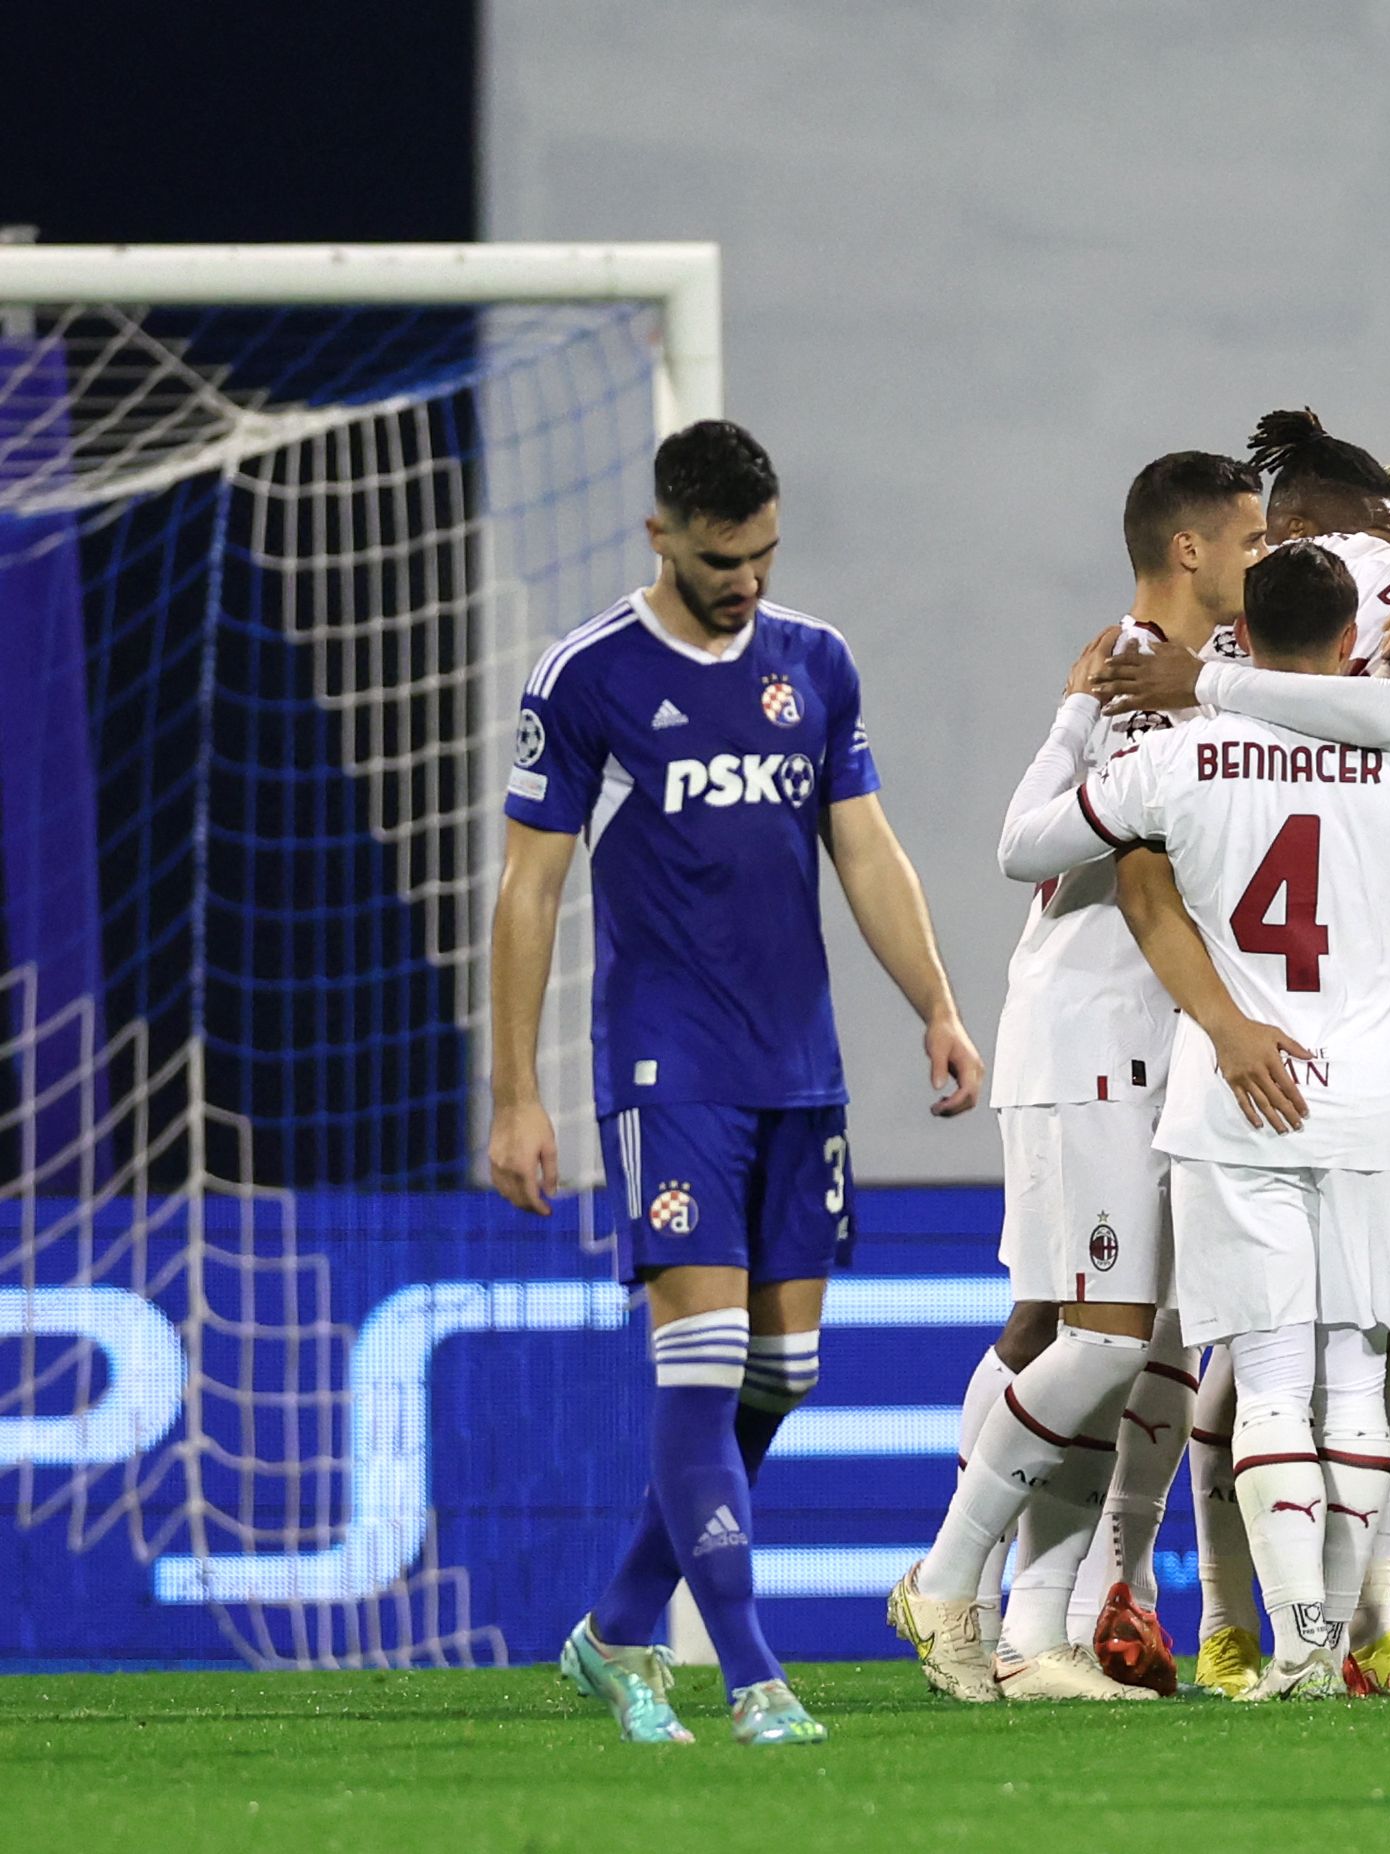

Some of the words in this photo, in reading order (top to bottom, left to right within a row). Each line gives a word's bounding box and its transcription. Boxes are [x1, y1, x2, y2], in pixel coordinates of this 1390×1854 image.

[664, 752, 785, 814] PSK
[1197, 741, 1383, 785] BENNACER
[1229, 813, 1329, 993] 4
